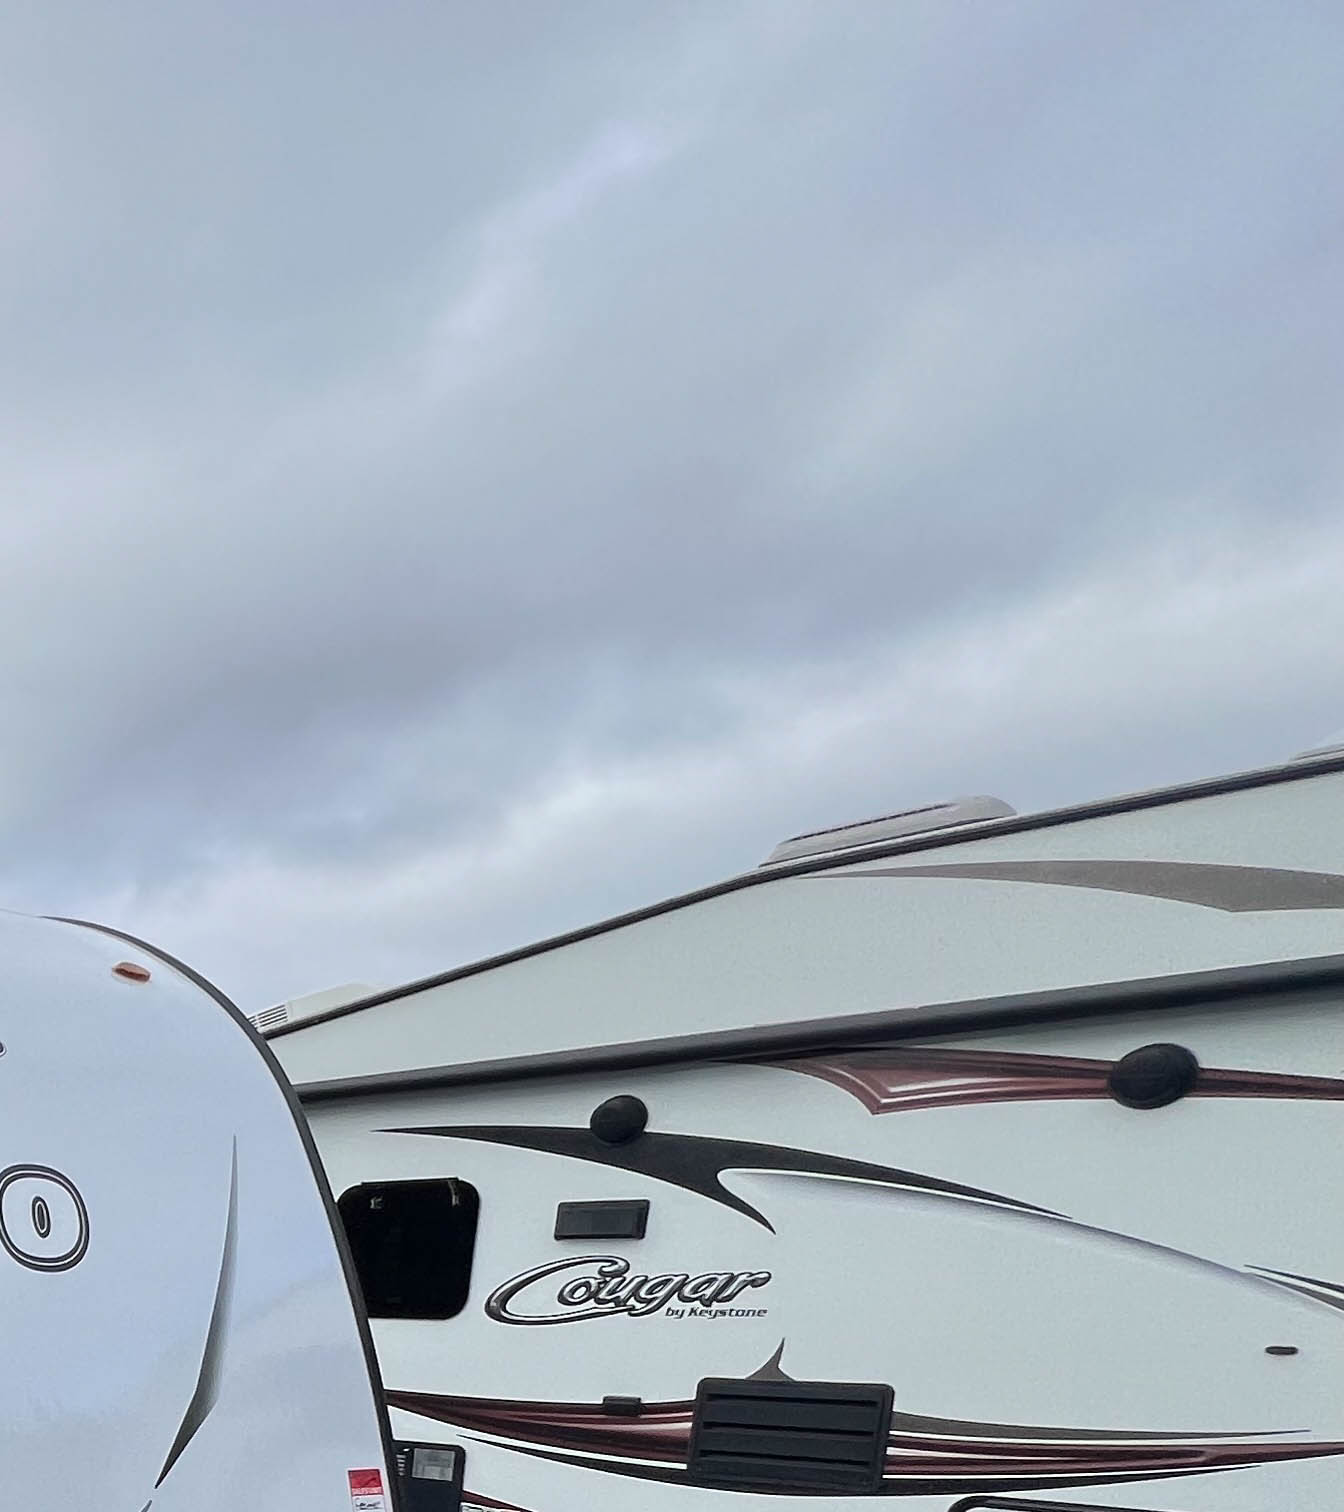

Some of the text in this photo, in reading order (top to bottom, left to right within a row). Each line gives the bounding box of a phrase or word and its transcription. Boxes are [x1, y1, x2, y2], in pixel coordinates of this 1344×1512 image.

[484, 1255, 772, 1326] Cougar
[665, 1306, 768, 1320] by Keystone
